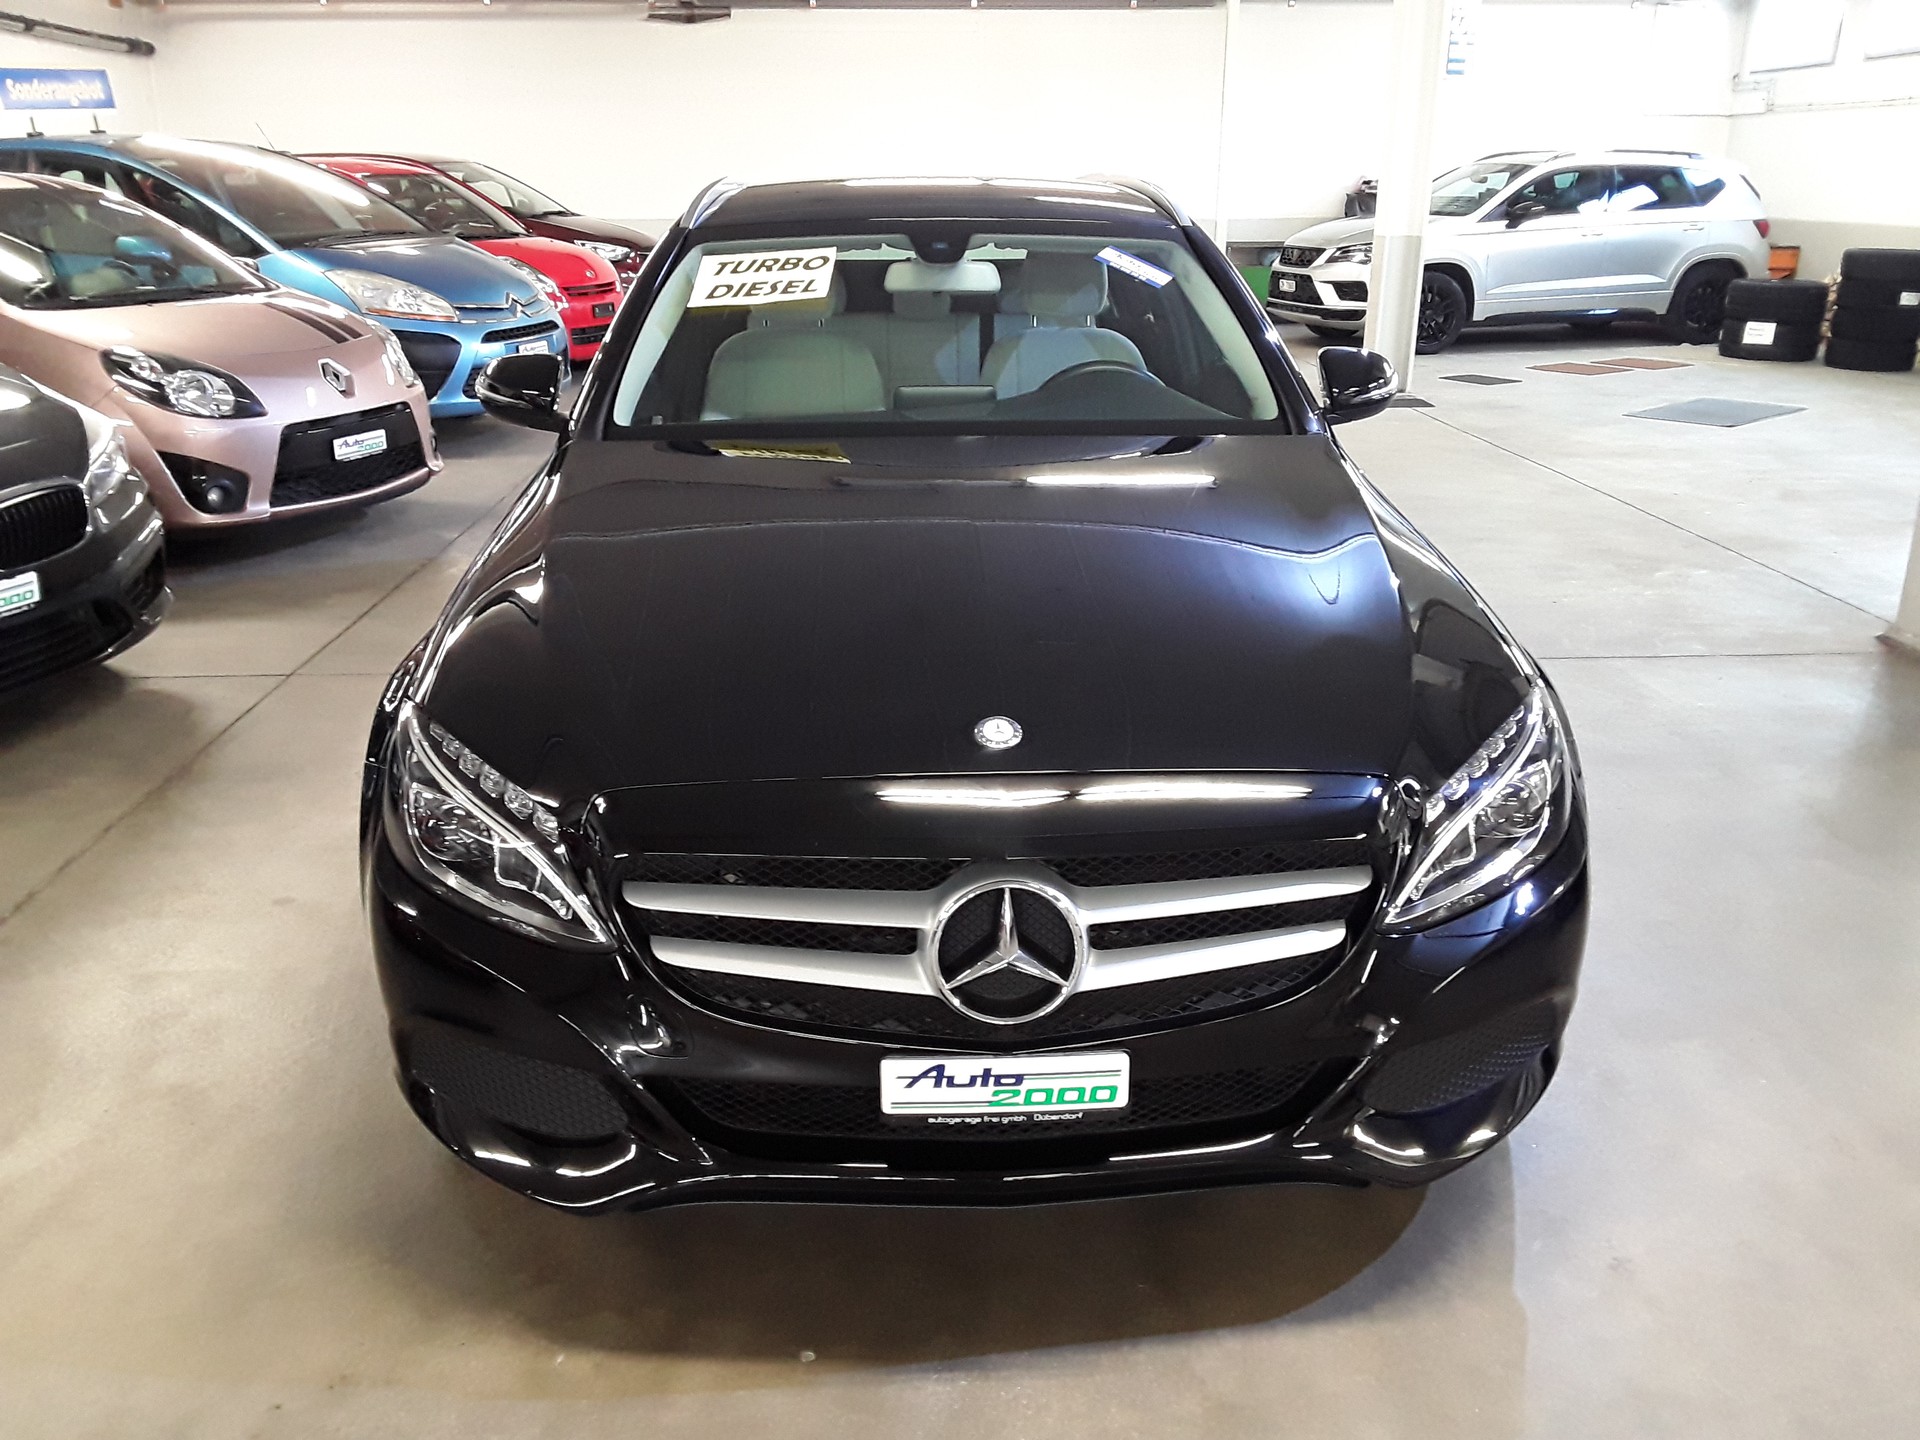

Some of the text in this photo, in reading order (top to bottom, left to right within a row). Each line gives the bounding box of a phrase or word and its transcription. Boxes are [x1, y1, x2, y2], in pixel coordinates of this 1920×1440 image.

[714, 255, 830, 276] TURBO
[705, 279, 817, 299] DIESEL
[904, 1064, 1024, 1088] Auto
[988, 1085, 1119, 1107] 2000
